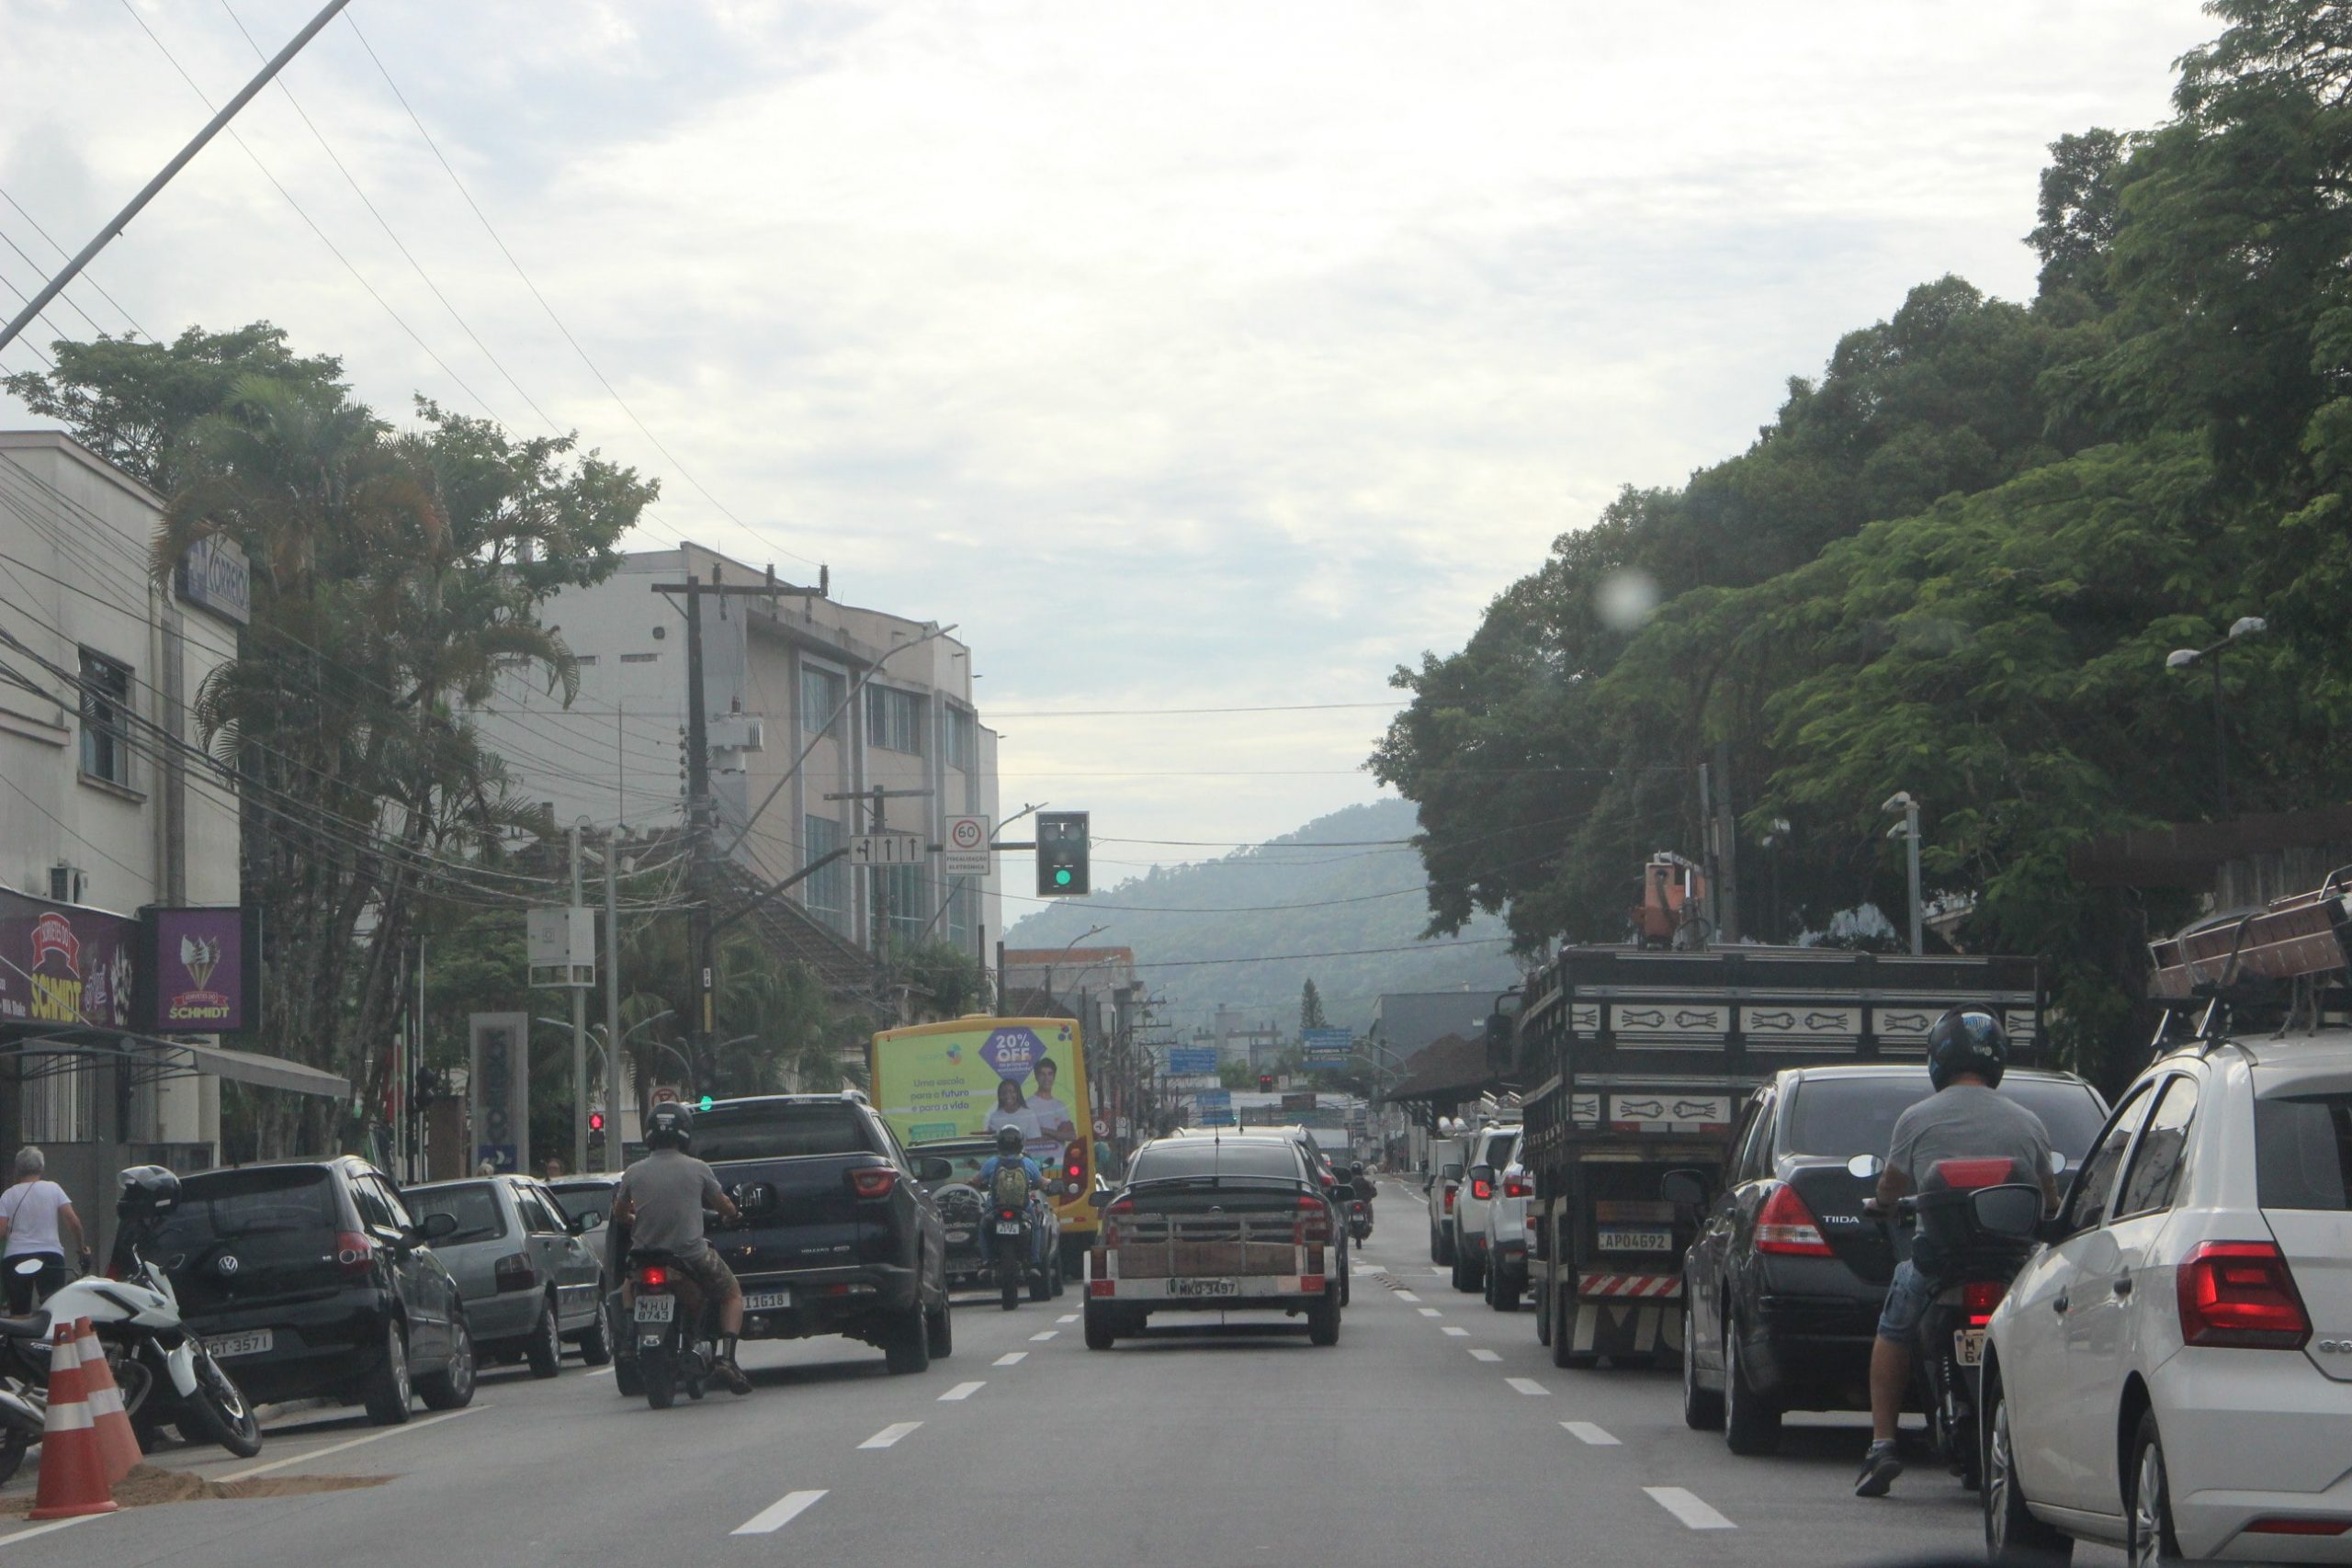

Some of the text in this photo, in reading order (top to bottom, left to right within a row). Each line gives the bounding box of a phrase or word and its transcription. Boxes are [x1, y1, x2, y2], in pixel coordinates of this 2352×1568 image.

[958, 826, 975, 838] 60
[31, 974, 82, 1023] SCHMIDT
[169, 1007, 229, 1020] SCHMIDT
[996, 1032, 1030, 1048] 20%
[997, 1048, 1030, 1062] OFF
[936, 1077, 965, 1086] escola
[910, 1093, 932, 1101] para
[942, 1089, 969, 1098] futuro
[920, 1104, 940, 1112] para
[950, 1100, 969, 1110] vida
[1823, 1215, 1860, 1224] TIIDA
